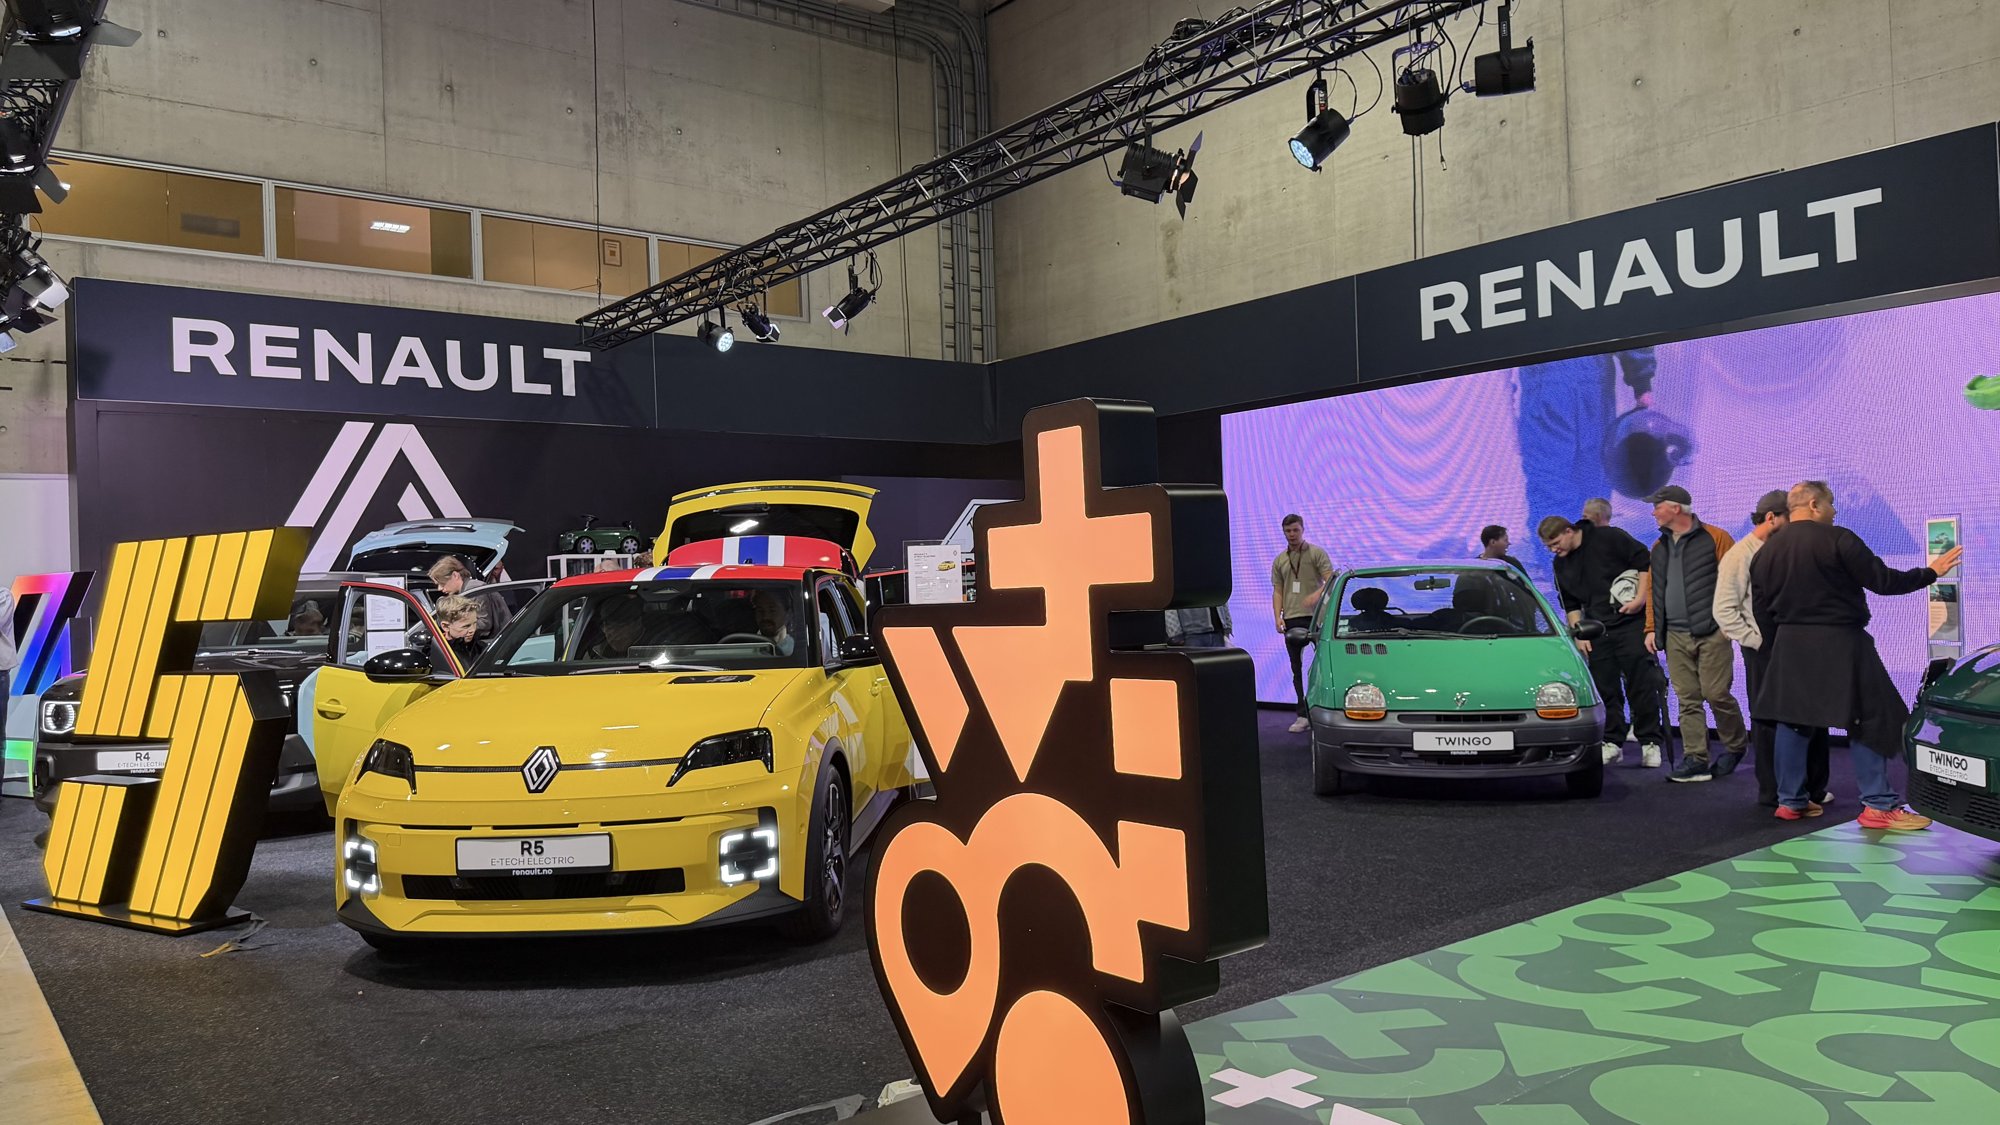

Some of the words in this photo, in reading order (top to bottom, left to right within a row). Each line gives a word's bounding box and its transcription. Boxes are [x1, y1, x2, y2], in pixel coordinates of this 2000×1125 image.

[1420, 187, 1883, 341] RENAULT
[171, 317, 592, 397] RENAULT
[1435, 736, 1492, 746] TWINGO
[135, 752, 150, 761] R4
[1929, 750, 1968, 770] TWINGO
[520, 841, 544, 855] R5
[491, 858, 525, 866] E-TECH
[527, 857, 575, 865] ELECTRIC
[512, 868, 553, 876] renault.no
